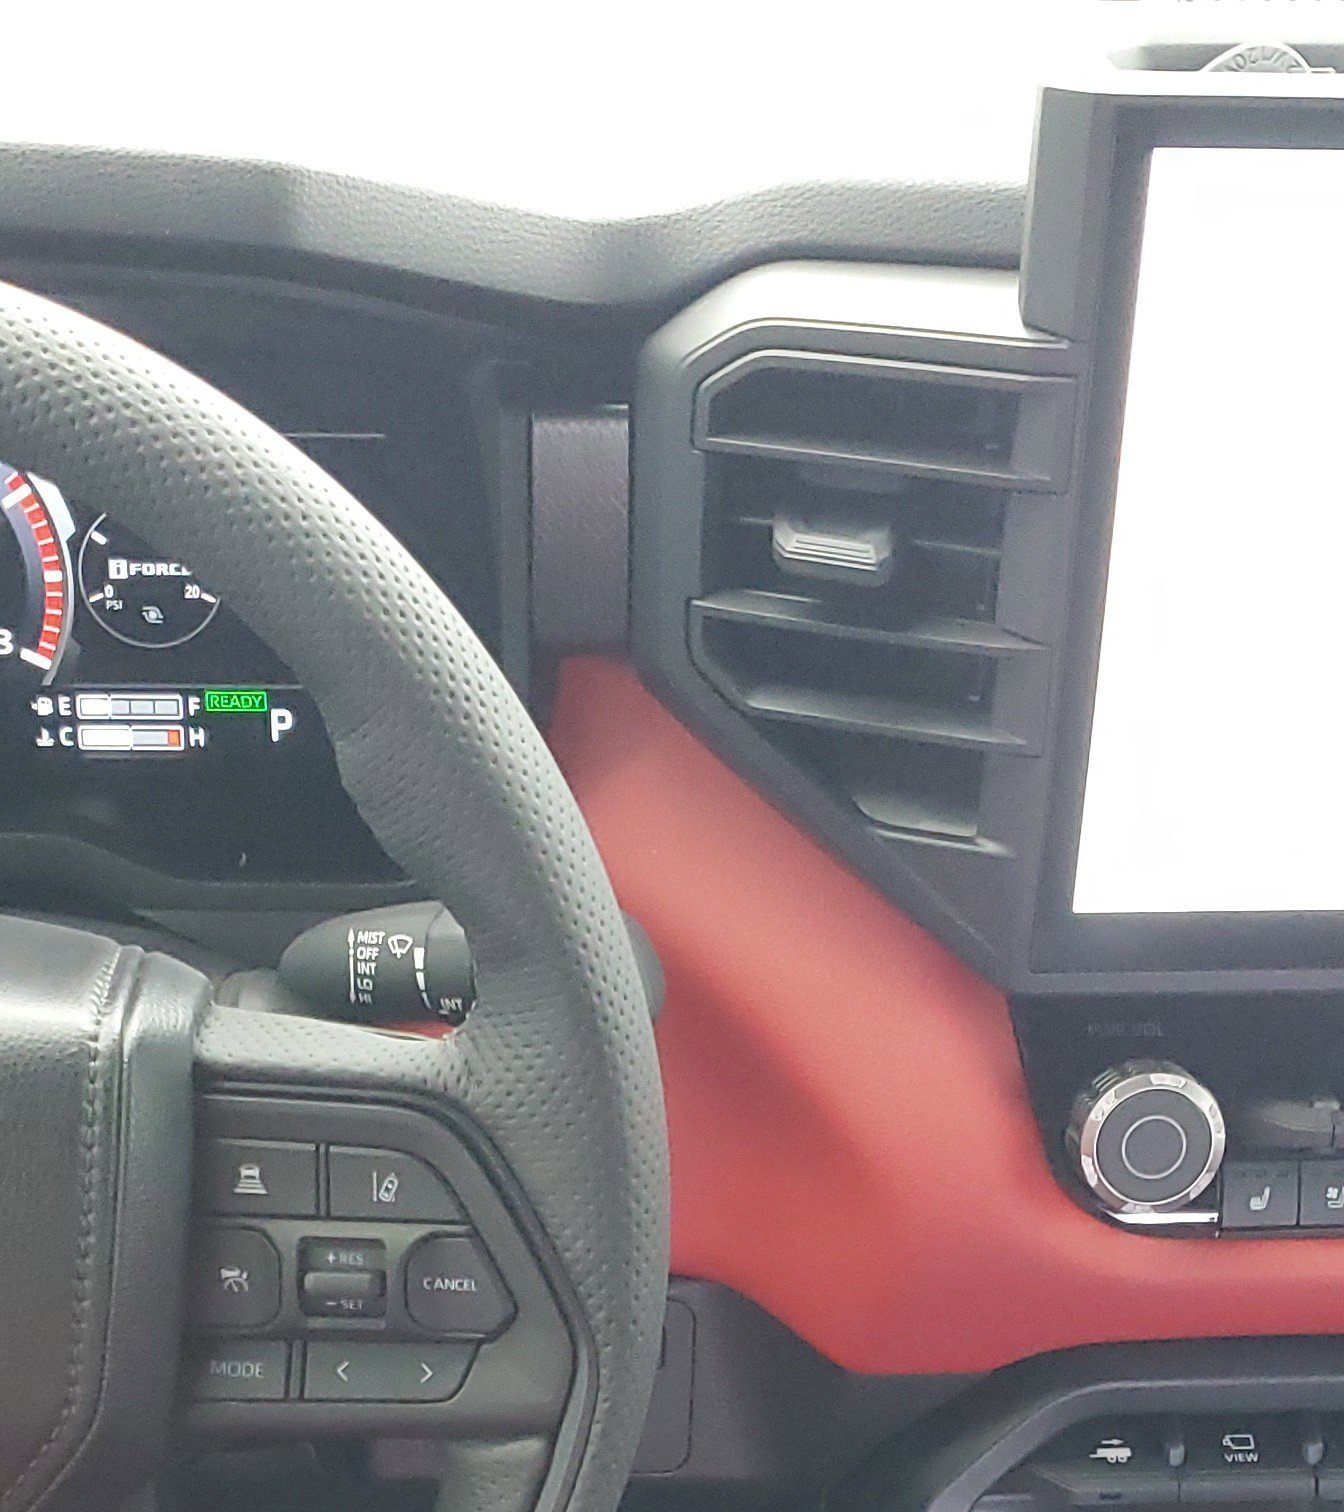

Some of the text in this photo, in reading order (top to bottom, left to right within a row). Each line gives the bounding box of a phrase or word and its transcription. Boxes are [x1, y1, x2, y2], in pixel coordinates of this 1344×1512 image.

[104, 583, 114, 599] 0
[184, 584, 200, 599] 20
[106, 600, 123, 611] PSI
[59, 696, 72, 716] E
[189, 696, 202, 717] F
[210, 694, 263, 710] READY
[270, 708, 293, 742] P
[60, 727, 75, 748] C
[189, 728, 205, 748] H
[357, 930, 386, 945] MIST
[357, 947, 379, 960] OFF
[357, 962, 376, 975] INT
[422, 1277, 477, 1293] CANCEL
[210, 1360, 265, 1380] MODE
[1224, 1451, 1259, 1464] VIEW
